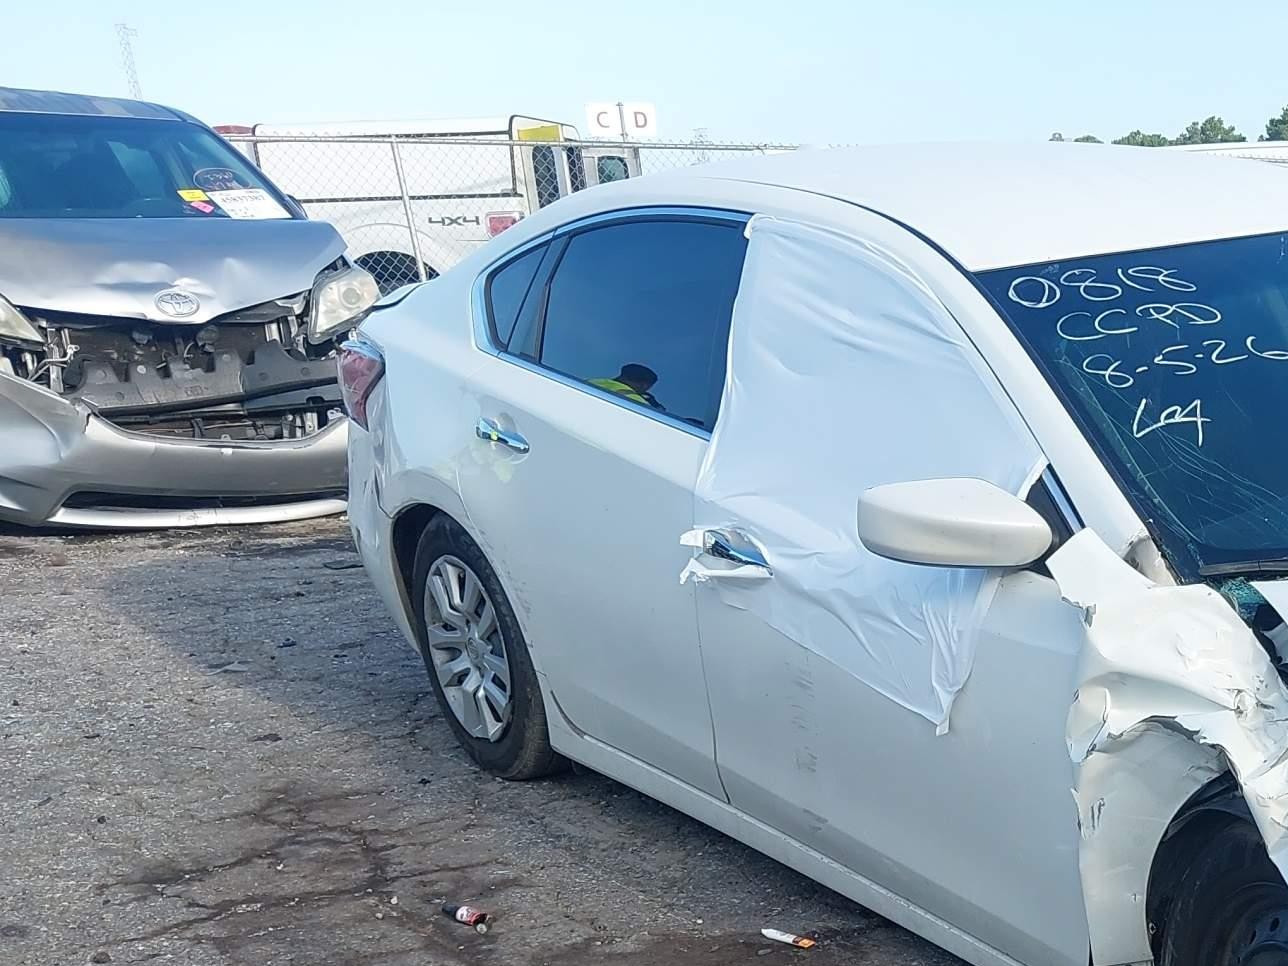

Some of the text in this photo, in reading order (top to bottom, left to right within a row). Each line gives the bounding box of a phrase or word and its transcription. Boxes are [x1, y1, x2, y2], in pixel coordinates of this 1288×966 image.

[595, 111, 610, 129] C
[633, 111, 648, 129] D
[1008, 266, 1198, 309] 0818
